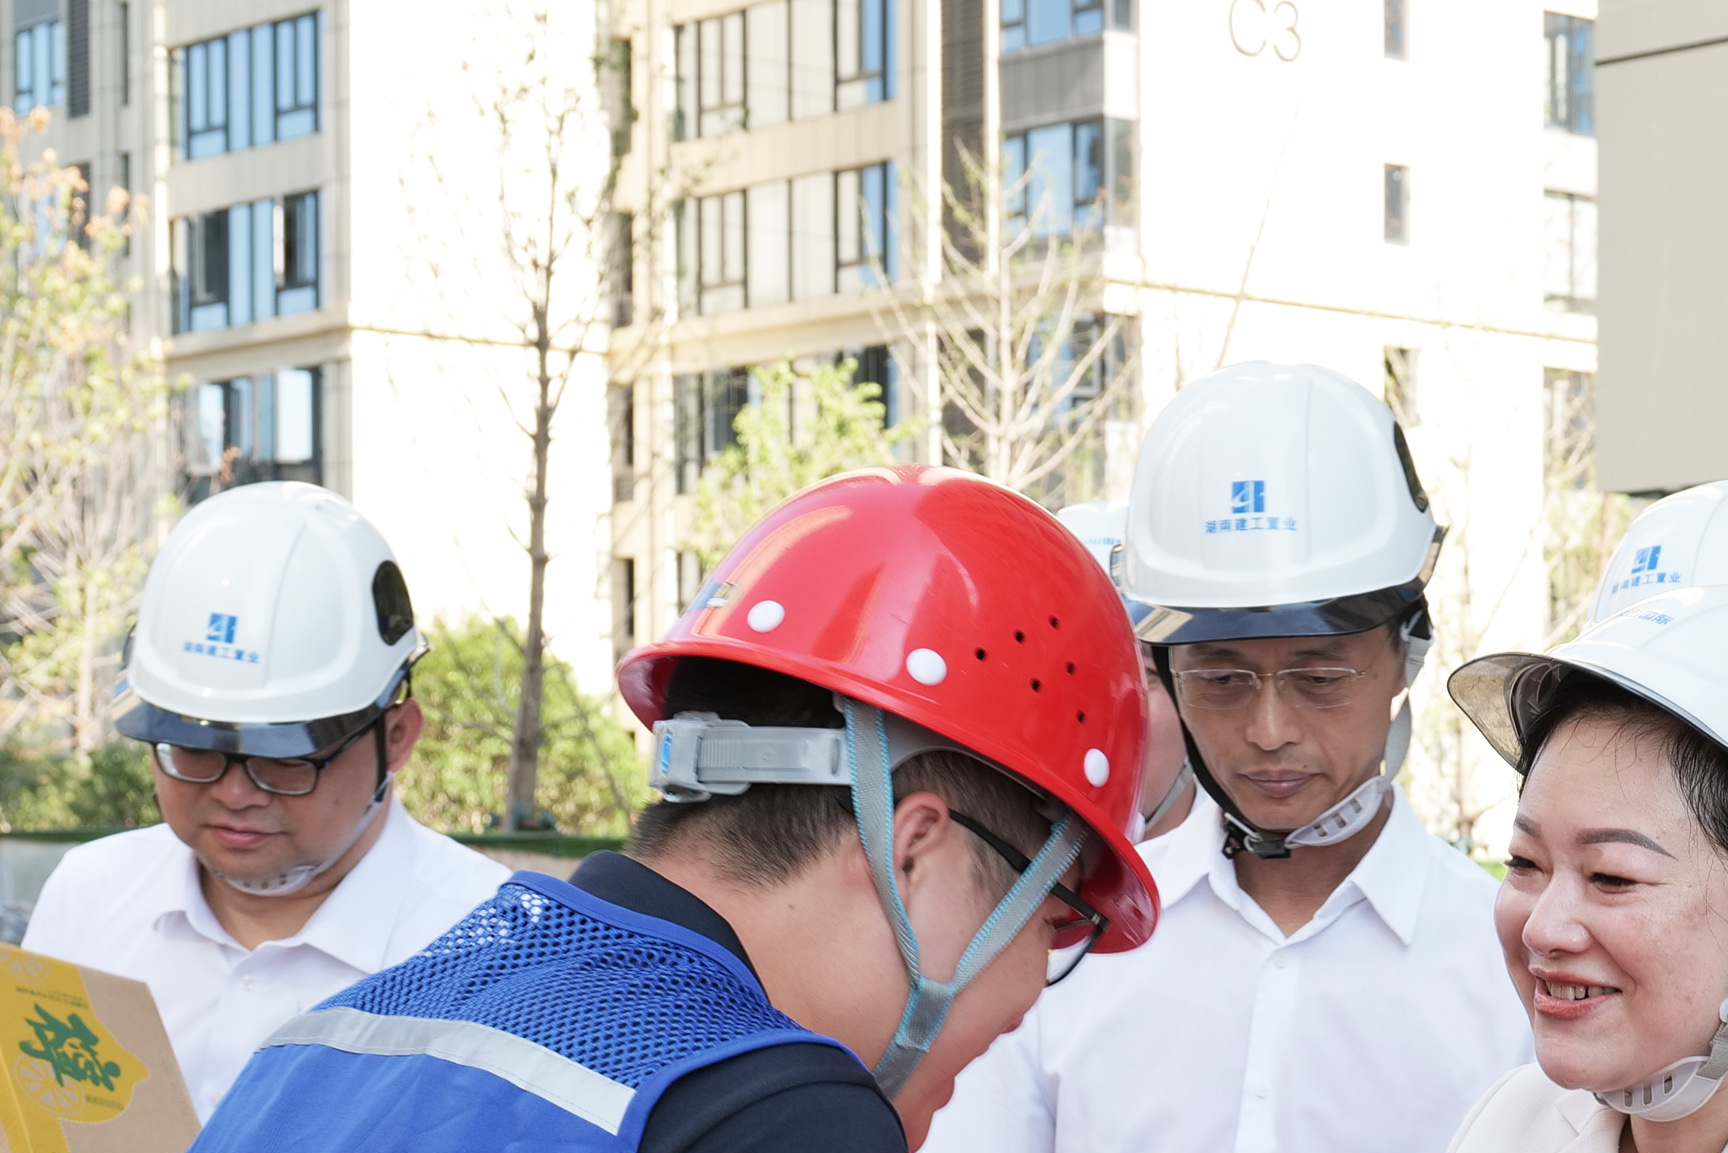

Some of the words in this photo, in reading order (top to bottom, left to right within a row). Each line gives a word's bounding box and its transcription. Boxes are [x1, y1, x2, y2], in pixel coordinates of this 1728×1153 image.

[1227, 0, 1302, 62] C3
[1203, 516, 1298, 535] 湖南建工置业
